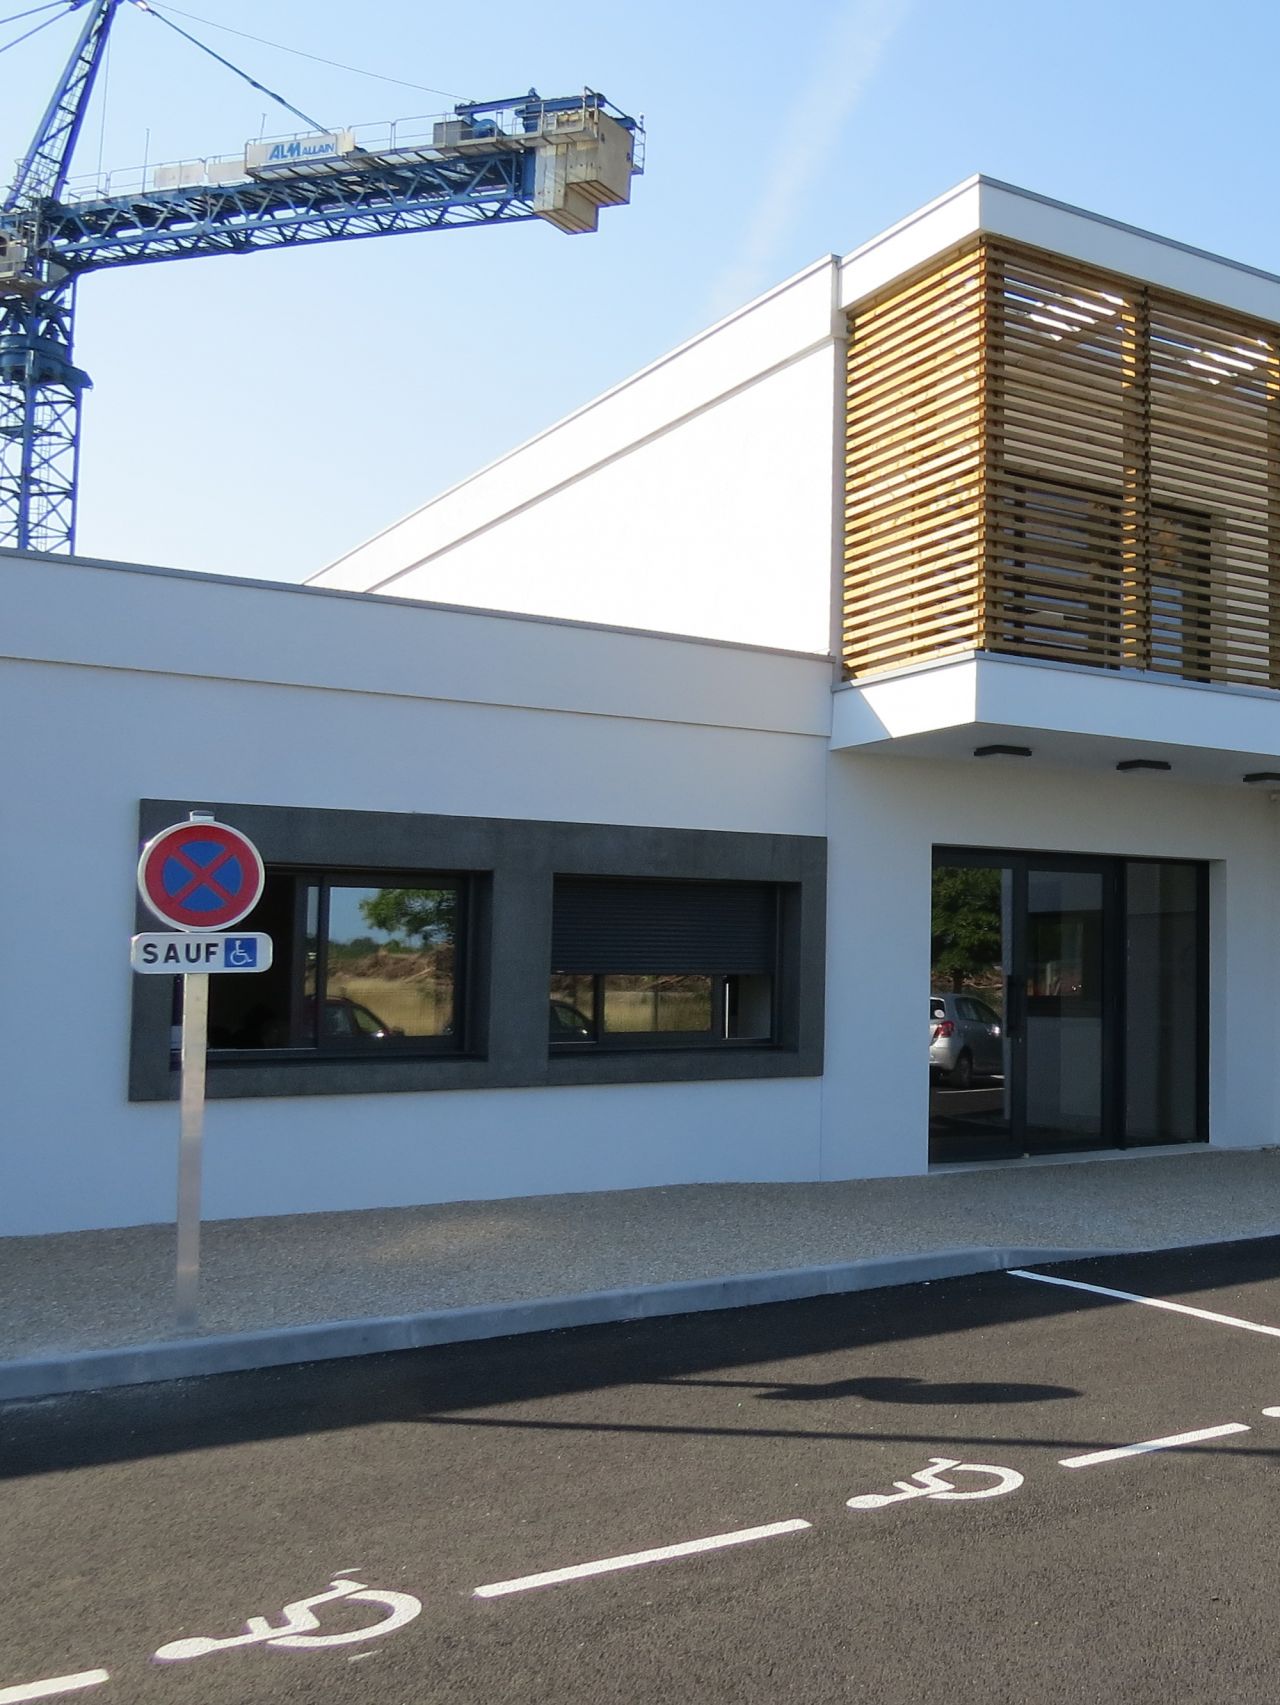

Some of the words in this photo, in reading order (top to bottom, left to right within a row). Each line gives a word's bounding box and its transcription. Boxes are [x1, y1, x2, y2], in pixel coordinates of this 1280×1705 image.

[269, 142, 301, 160] ALM
[302, 143, 335, 155] ALLAIN
[143, 943, 218, 964] SAUF
